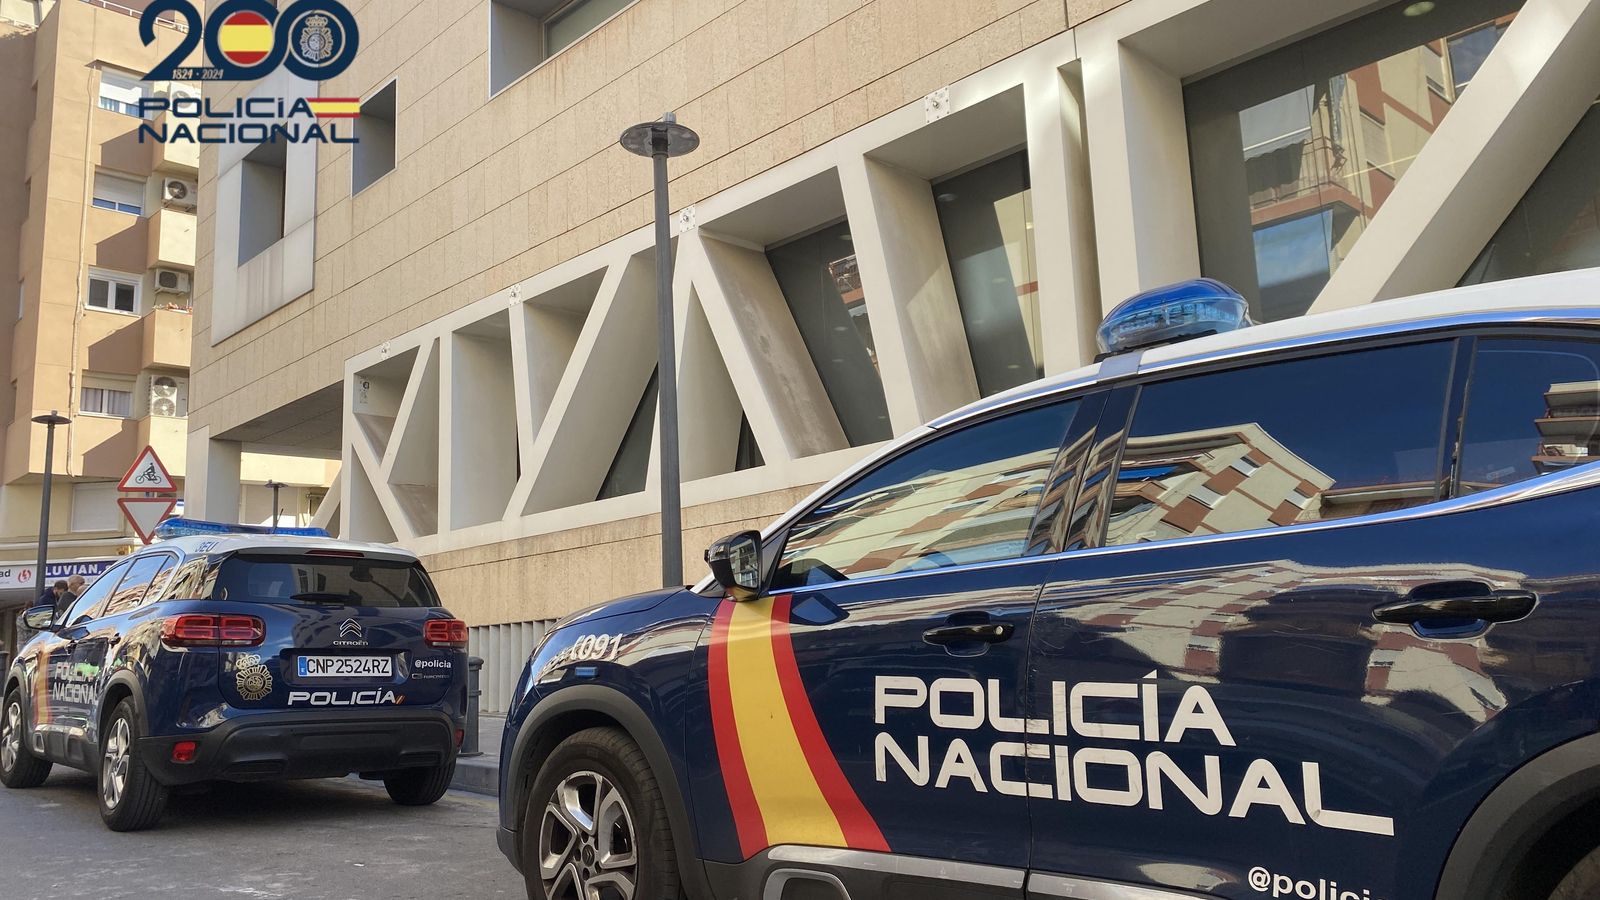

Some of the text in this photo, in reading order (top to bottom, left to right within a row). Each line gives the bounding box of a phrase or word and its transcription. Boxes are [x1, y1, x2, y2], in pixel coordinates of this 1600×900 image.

[287, 687, 396, 706] POLICÍA
[874, 669, 1237, 747] POLICÍA
[874, 731, 1395, 836] NACIONAL
[1248, 865, 1386, 900] @poli
